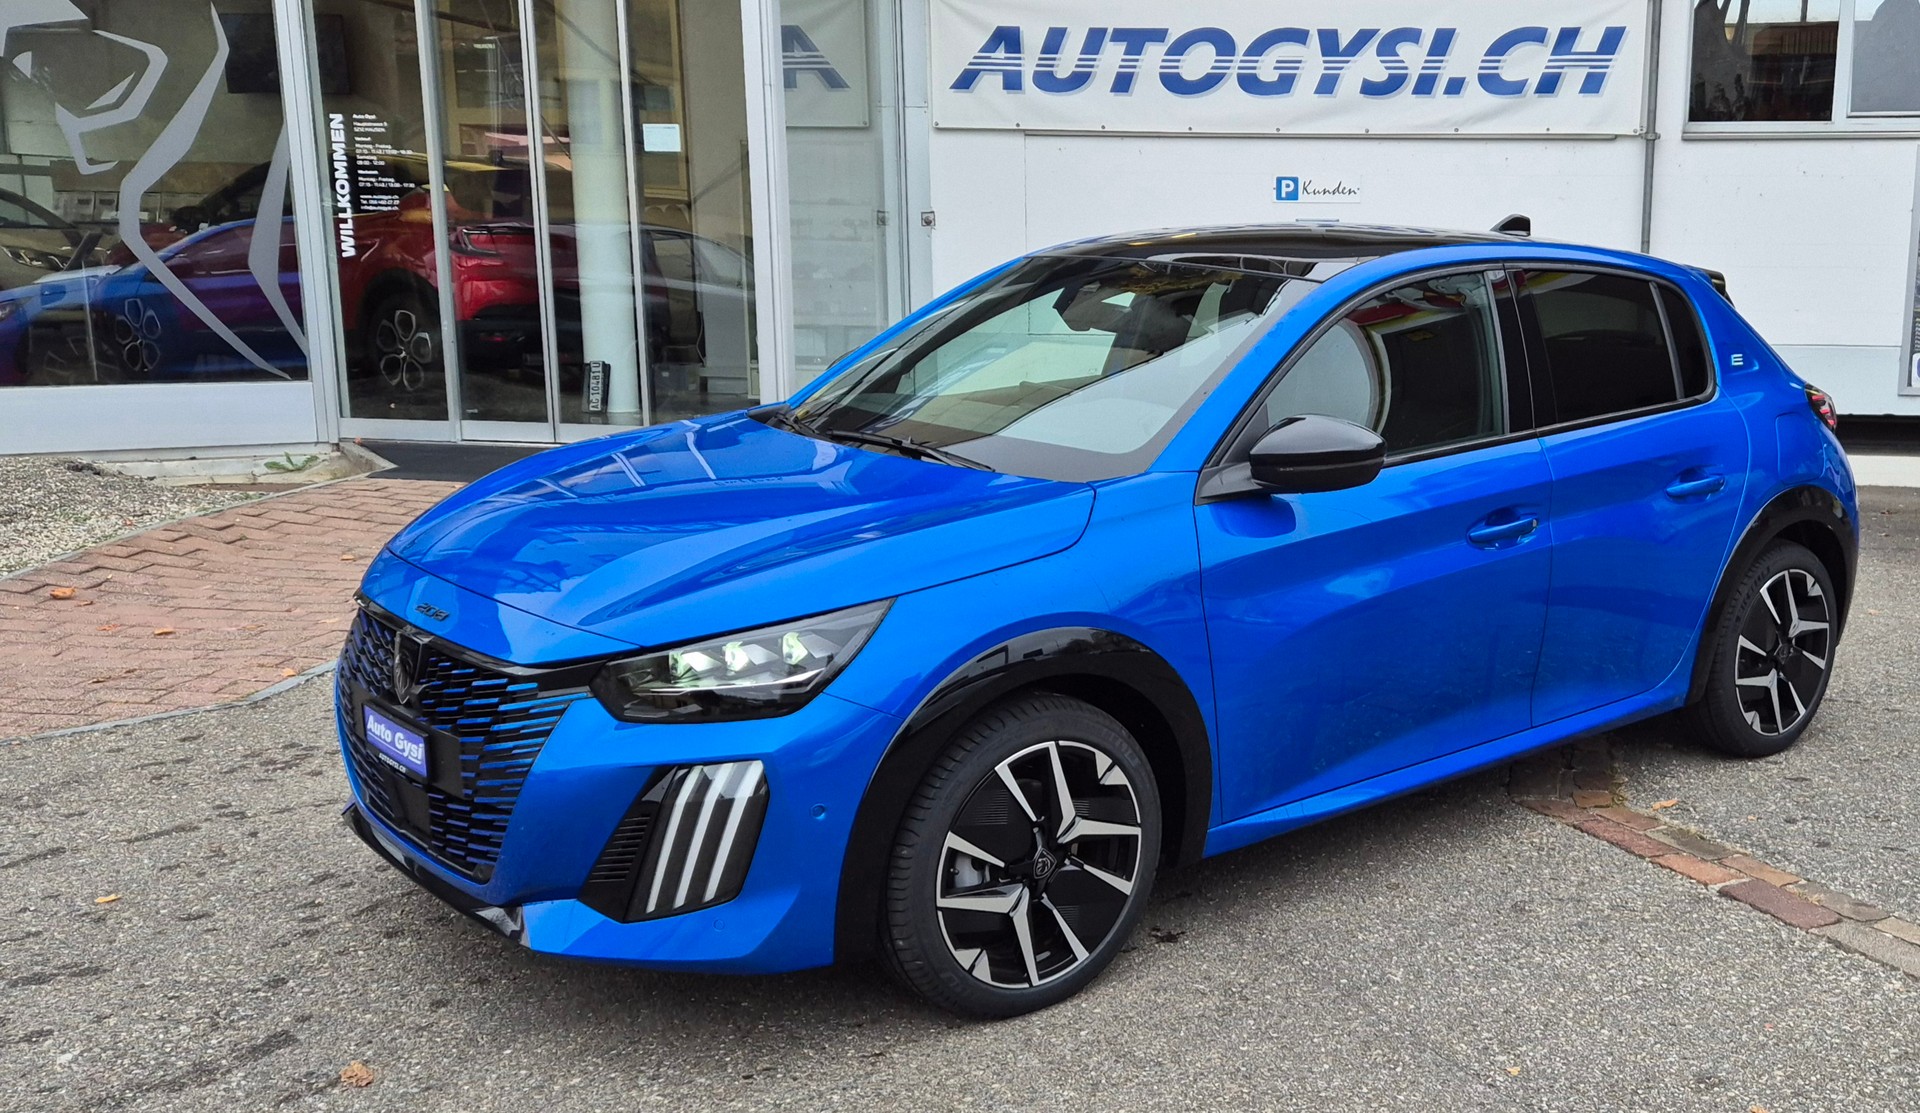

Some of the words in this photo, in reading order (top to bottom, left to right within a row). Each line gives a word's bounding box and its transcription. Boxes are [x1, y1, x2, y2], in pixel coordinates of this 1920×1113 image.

[949, 25, 1628, 97] AUTOGYSI.CH
[329, 113, 356, 258] WILLKOMMEN
[1281, 180, 1295, 198] P
[1302, 179, 1357, 196] Kunden
[415, 602, 449, 622] 208
[367, 714, 392, 743] Auto
[395, 732, 424, 760] Gysi
